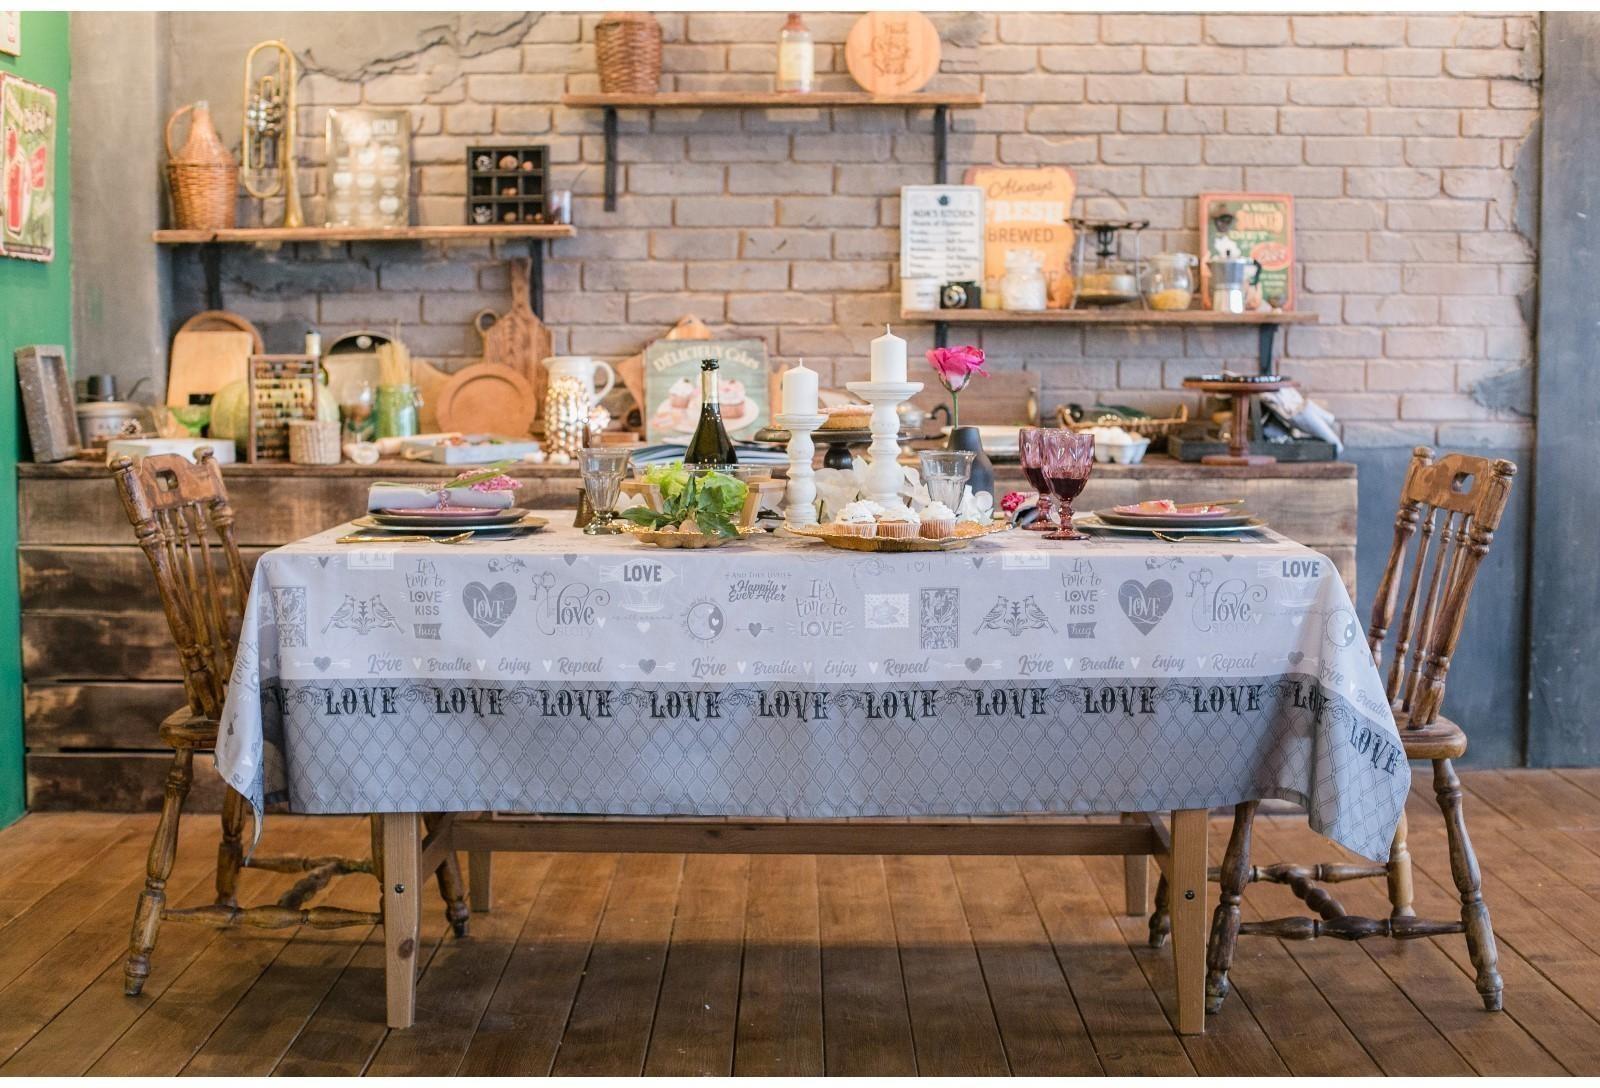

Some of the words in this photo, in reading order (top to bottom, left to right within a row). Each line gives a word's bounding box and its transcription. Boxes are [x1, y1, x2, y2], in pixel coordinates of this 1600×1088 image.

[987, 178, 1056, 199] Always
[987, 227, 1055, 243] BREWED
[623, 565, 662, 582] LOVE
[1282, 560, 1320, 578] LOVE
[736, 579, 779, 594] Happily
[409, 591, 443, 603] LOVE
[729, 591, 754, 603] Ever
[1064, 590, 1099, 602] LOVE
[415, 605, 440, 616] KISS
[472, 598, 505, 620] LOVE
[832, 597, 848, 616] to
[1069, 604, 1096, 615] KISS
[1127, 596, 1161, 618] LOVE
[800, 621, 844, 637] LOVE
[368, 655, 402, 676] Love
[427, 656, 472, 673] Breathe
[497, 656, 531, 675] Enjoy
[558, 656, 604, 676] Repeat
[691, 657, 727, 678] Love
[753, 660, 798, 675] Breathe
[824, 660, 857, 678] Enjoy
[883, 657, 930, 677] Repeat
[1018, 654, 1054, 676] Love
[1079, 655, 1125, 672] Breathe
[1151, 655, 1185, 672] Enjoy
[1211, 653, 1257, 672] Repeat
[325, 686, 398, 717] LOVE
[433, 686, 505, 717] LOVE
[540, 689, 612, 720] LOVE
[648, 690, 721, 721] LOVE
[756, 690, 829, 722] LOVE
[864, 689, 938, 721] LOVE
[973, 688, 1047, 718] LOVE
[1081, 686, 1158, 716] LOVE
[1191, 685, 1263, 716] LOVE
[1349, 717, 1402, 777] LOVE
